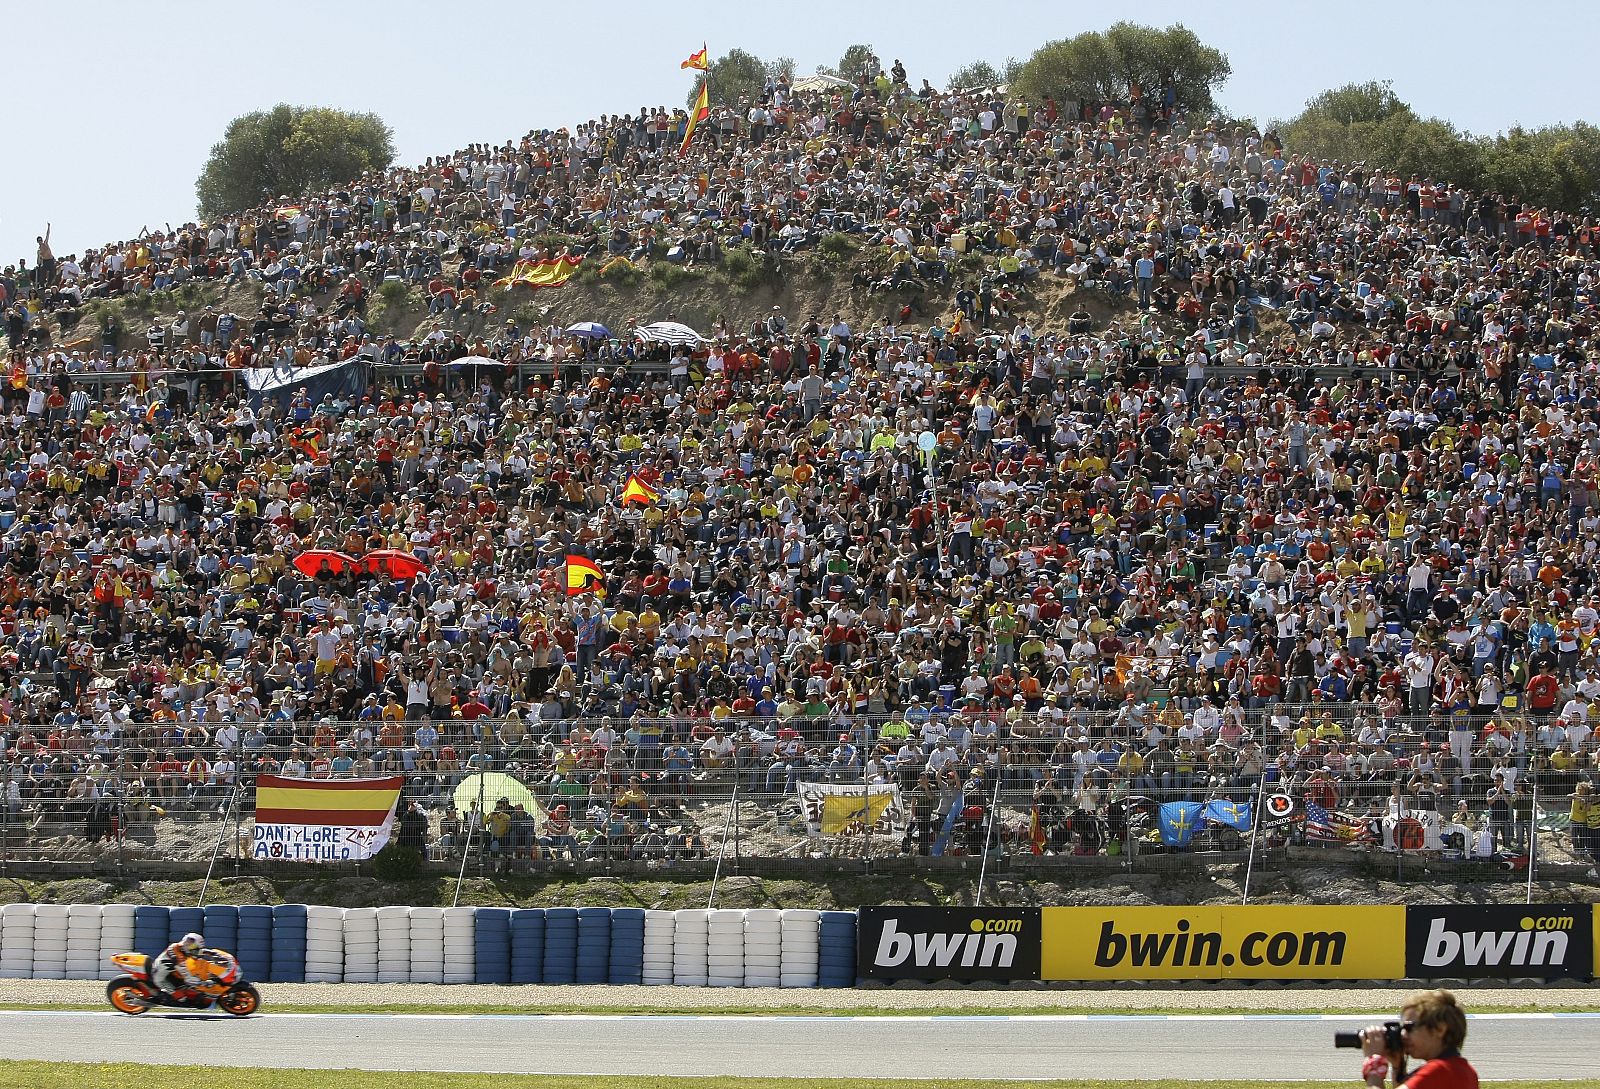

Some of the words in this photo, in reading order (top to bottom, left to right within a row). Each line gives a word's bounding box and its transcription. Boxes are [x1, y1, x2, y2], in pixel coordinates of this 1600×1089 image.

[874, 918, 1018, 967] bwin
[1094, 918, 1347, 968] bwin.com
[1421, 917, 1569, 967] bwin
